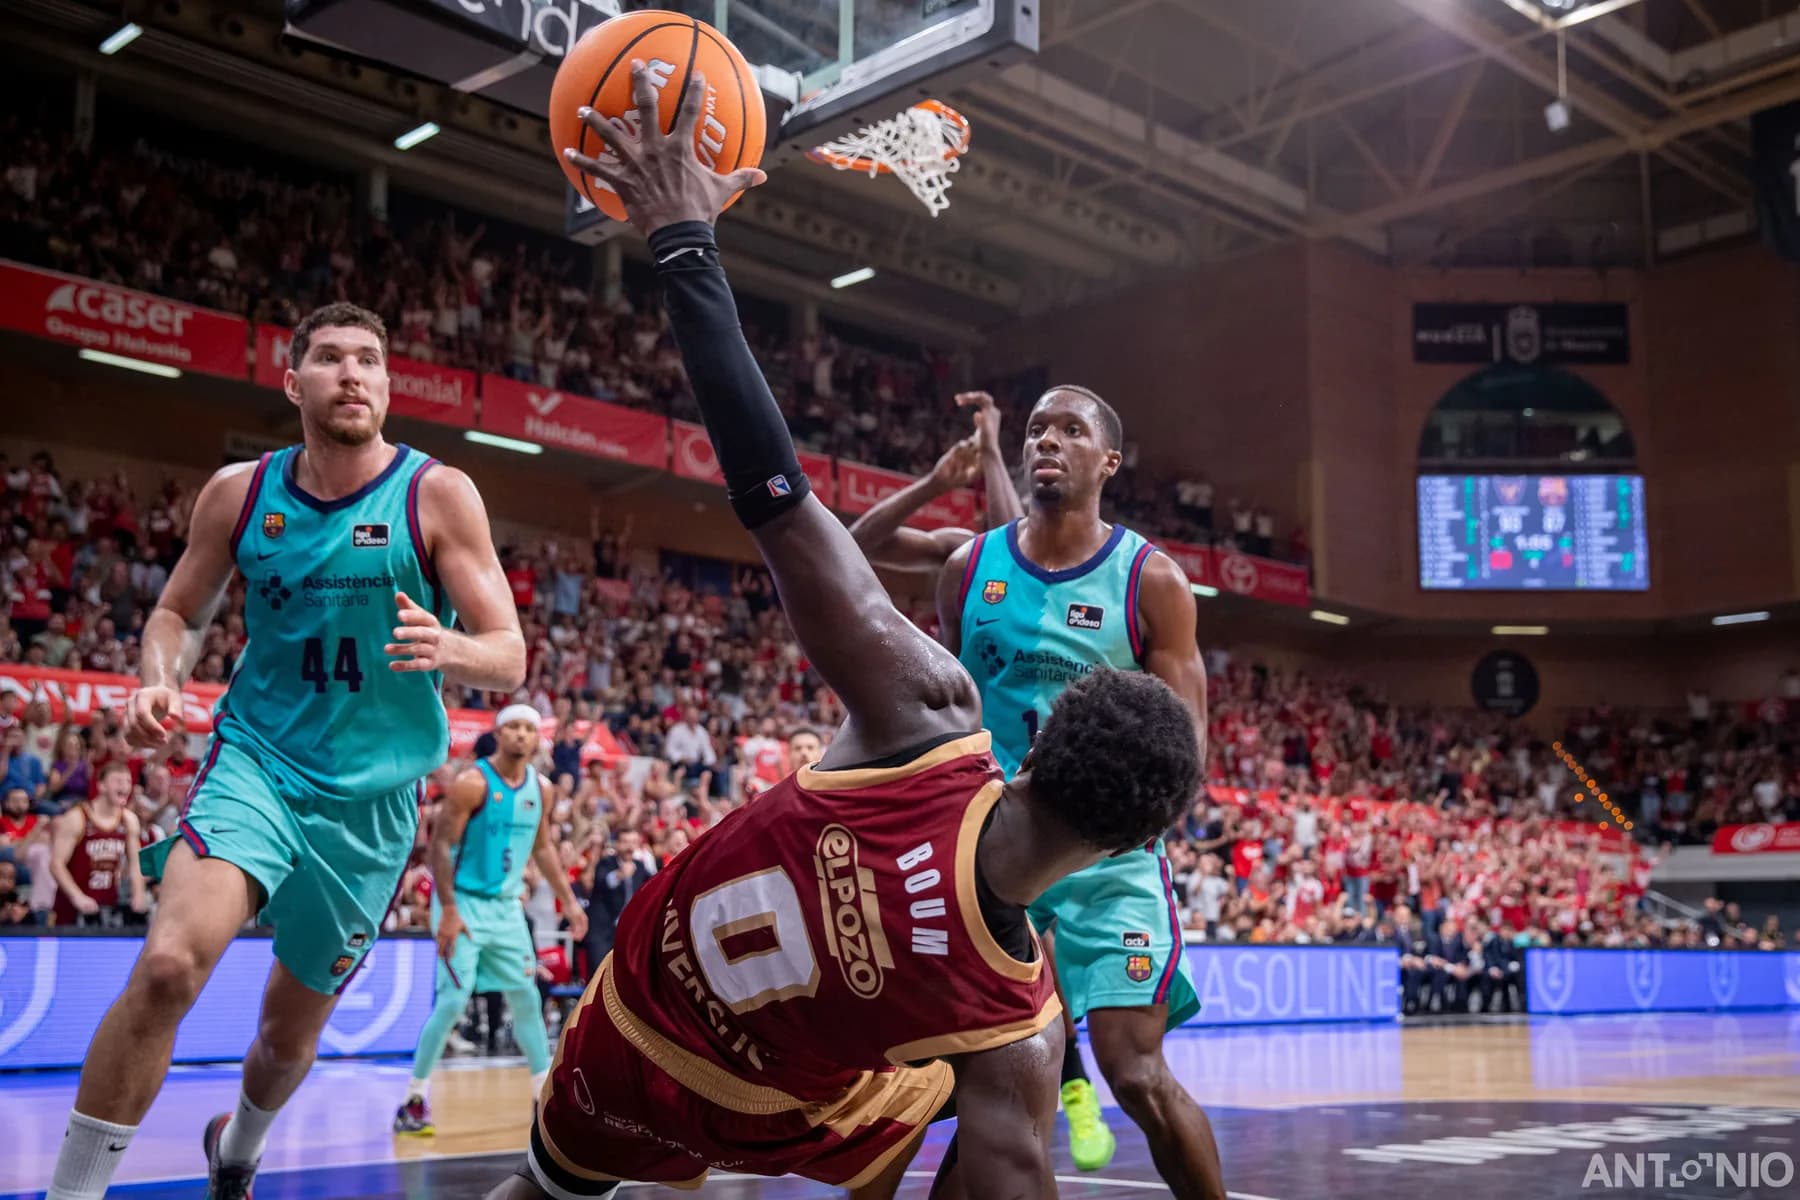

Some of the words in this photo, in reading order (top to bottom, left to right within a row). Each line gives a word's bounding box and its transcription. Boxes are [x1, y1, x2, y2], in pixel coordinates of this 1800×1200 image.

[46, 316, 111, 347] Grupo
[77, 288, 193, 336] caser
[302, 637, 364, 692] 44
[1014, 648, 1100, 674] Assistènc
[896, 841, 949, 956] BOUM
[689, 864, 822, 1016] 0
[1124, 937, 1146, 947] acb
[1186, 949, 1399, 1020] ASOLINE
